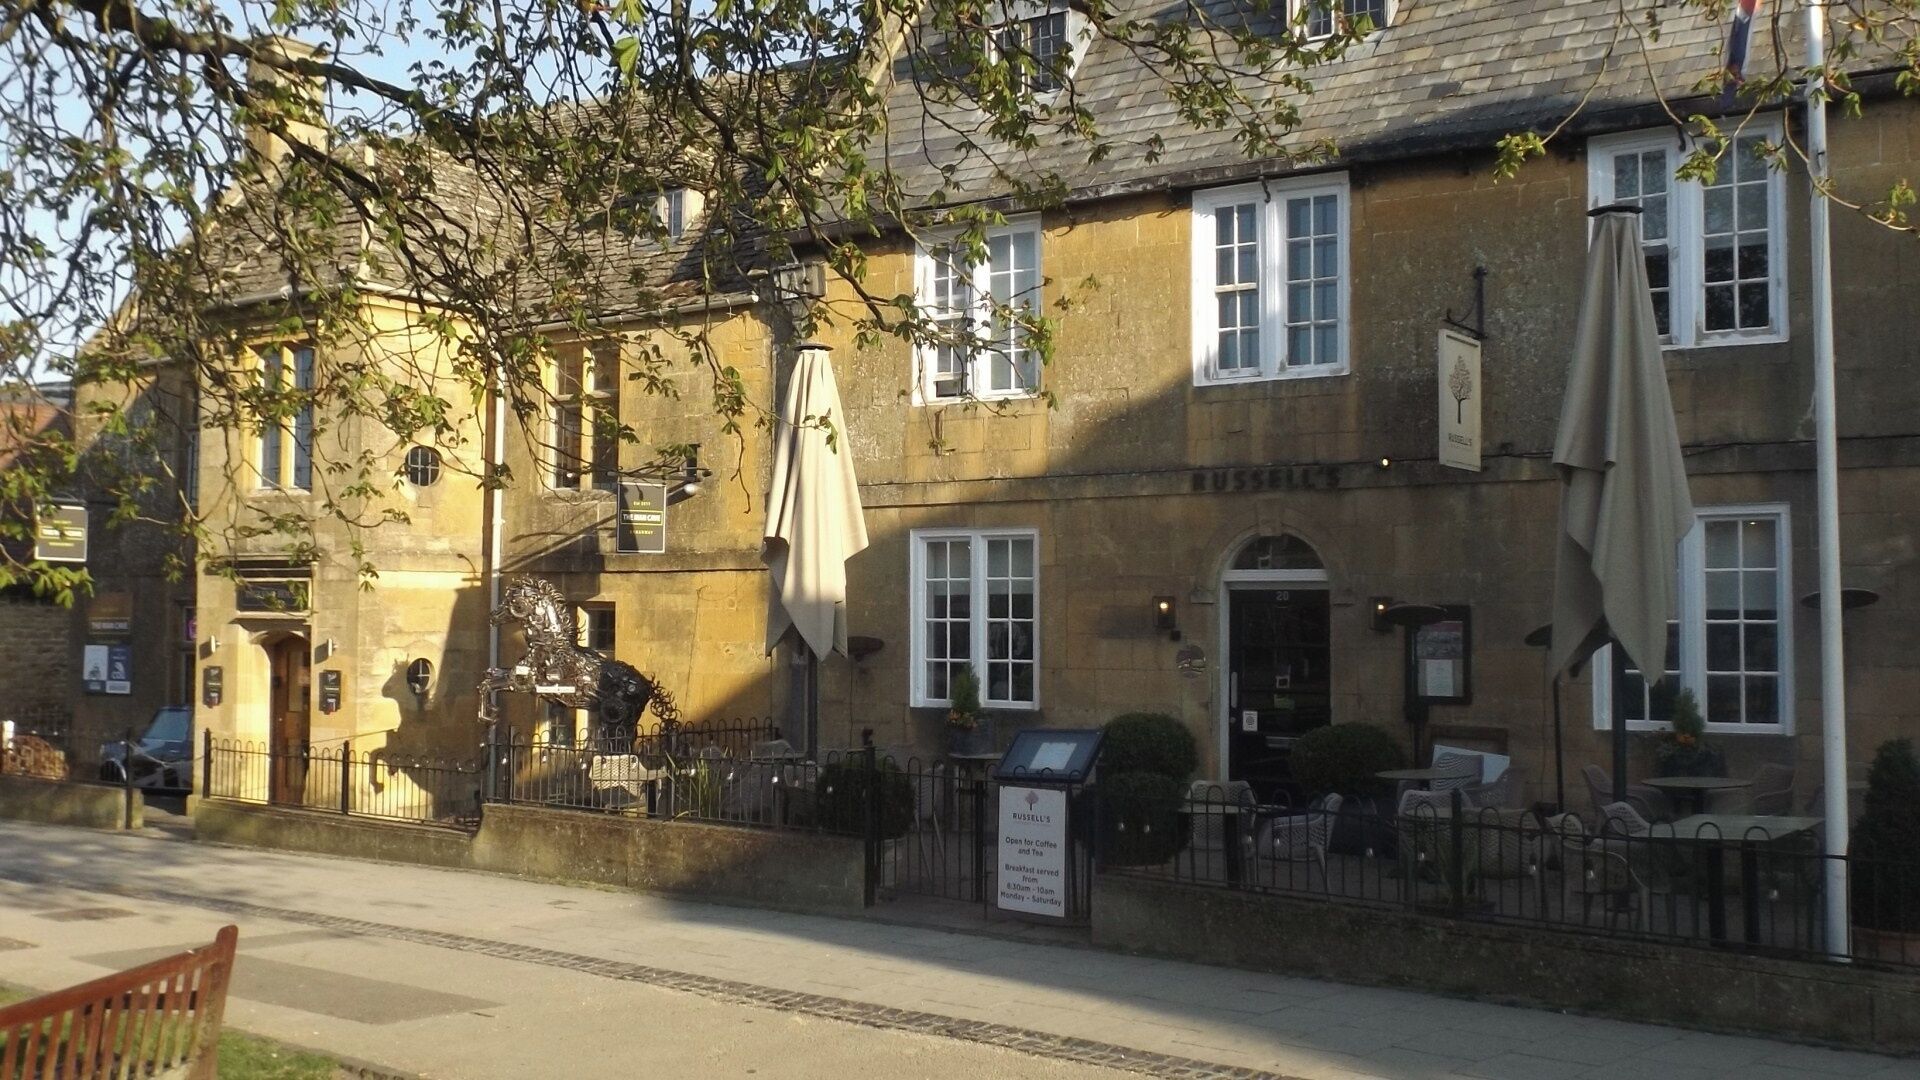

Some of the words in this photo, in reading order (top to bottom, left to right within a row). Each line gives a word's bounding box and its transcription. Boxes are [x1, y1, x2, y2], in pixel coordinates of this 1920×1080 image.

[1276, 591, 1288, 601] 20
[1013, 812, 1050, 823] RUSSELL'S
[1005, 837, 1022, 846] Open
[1024, 838, 1033, 846] for
[1035, 840, 1057, 849] Coffee
[1018, 848, 1030, 856] and
[1032, 849, 1043, 857] Tea
[1005, 863, 1035, 874] Breakfast
[1037, 868, 1059, 877] served
[1022, 875, 1038, 883] from
[1037, 887, 1055, 895] 10am
[1001, 891, 1024, 901] Monday
[1032, 895, 1061, 906] Saturday
